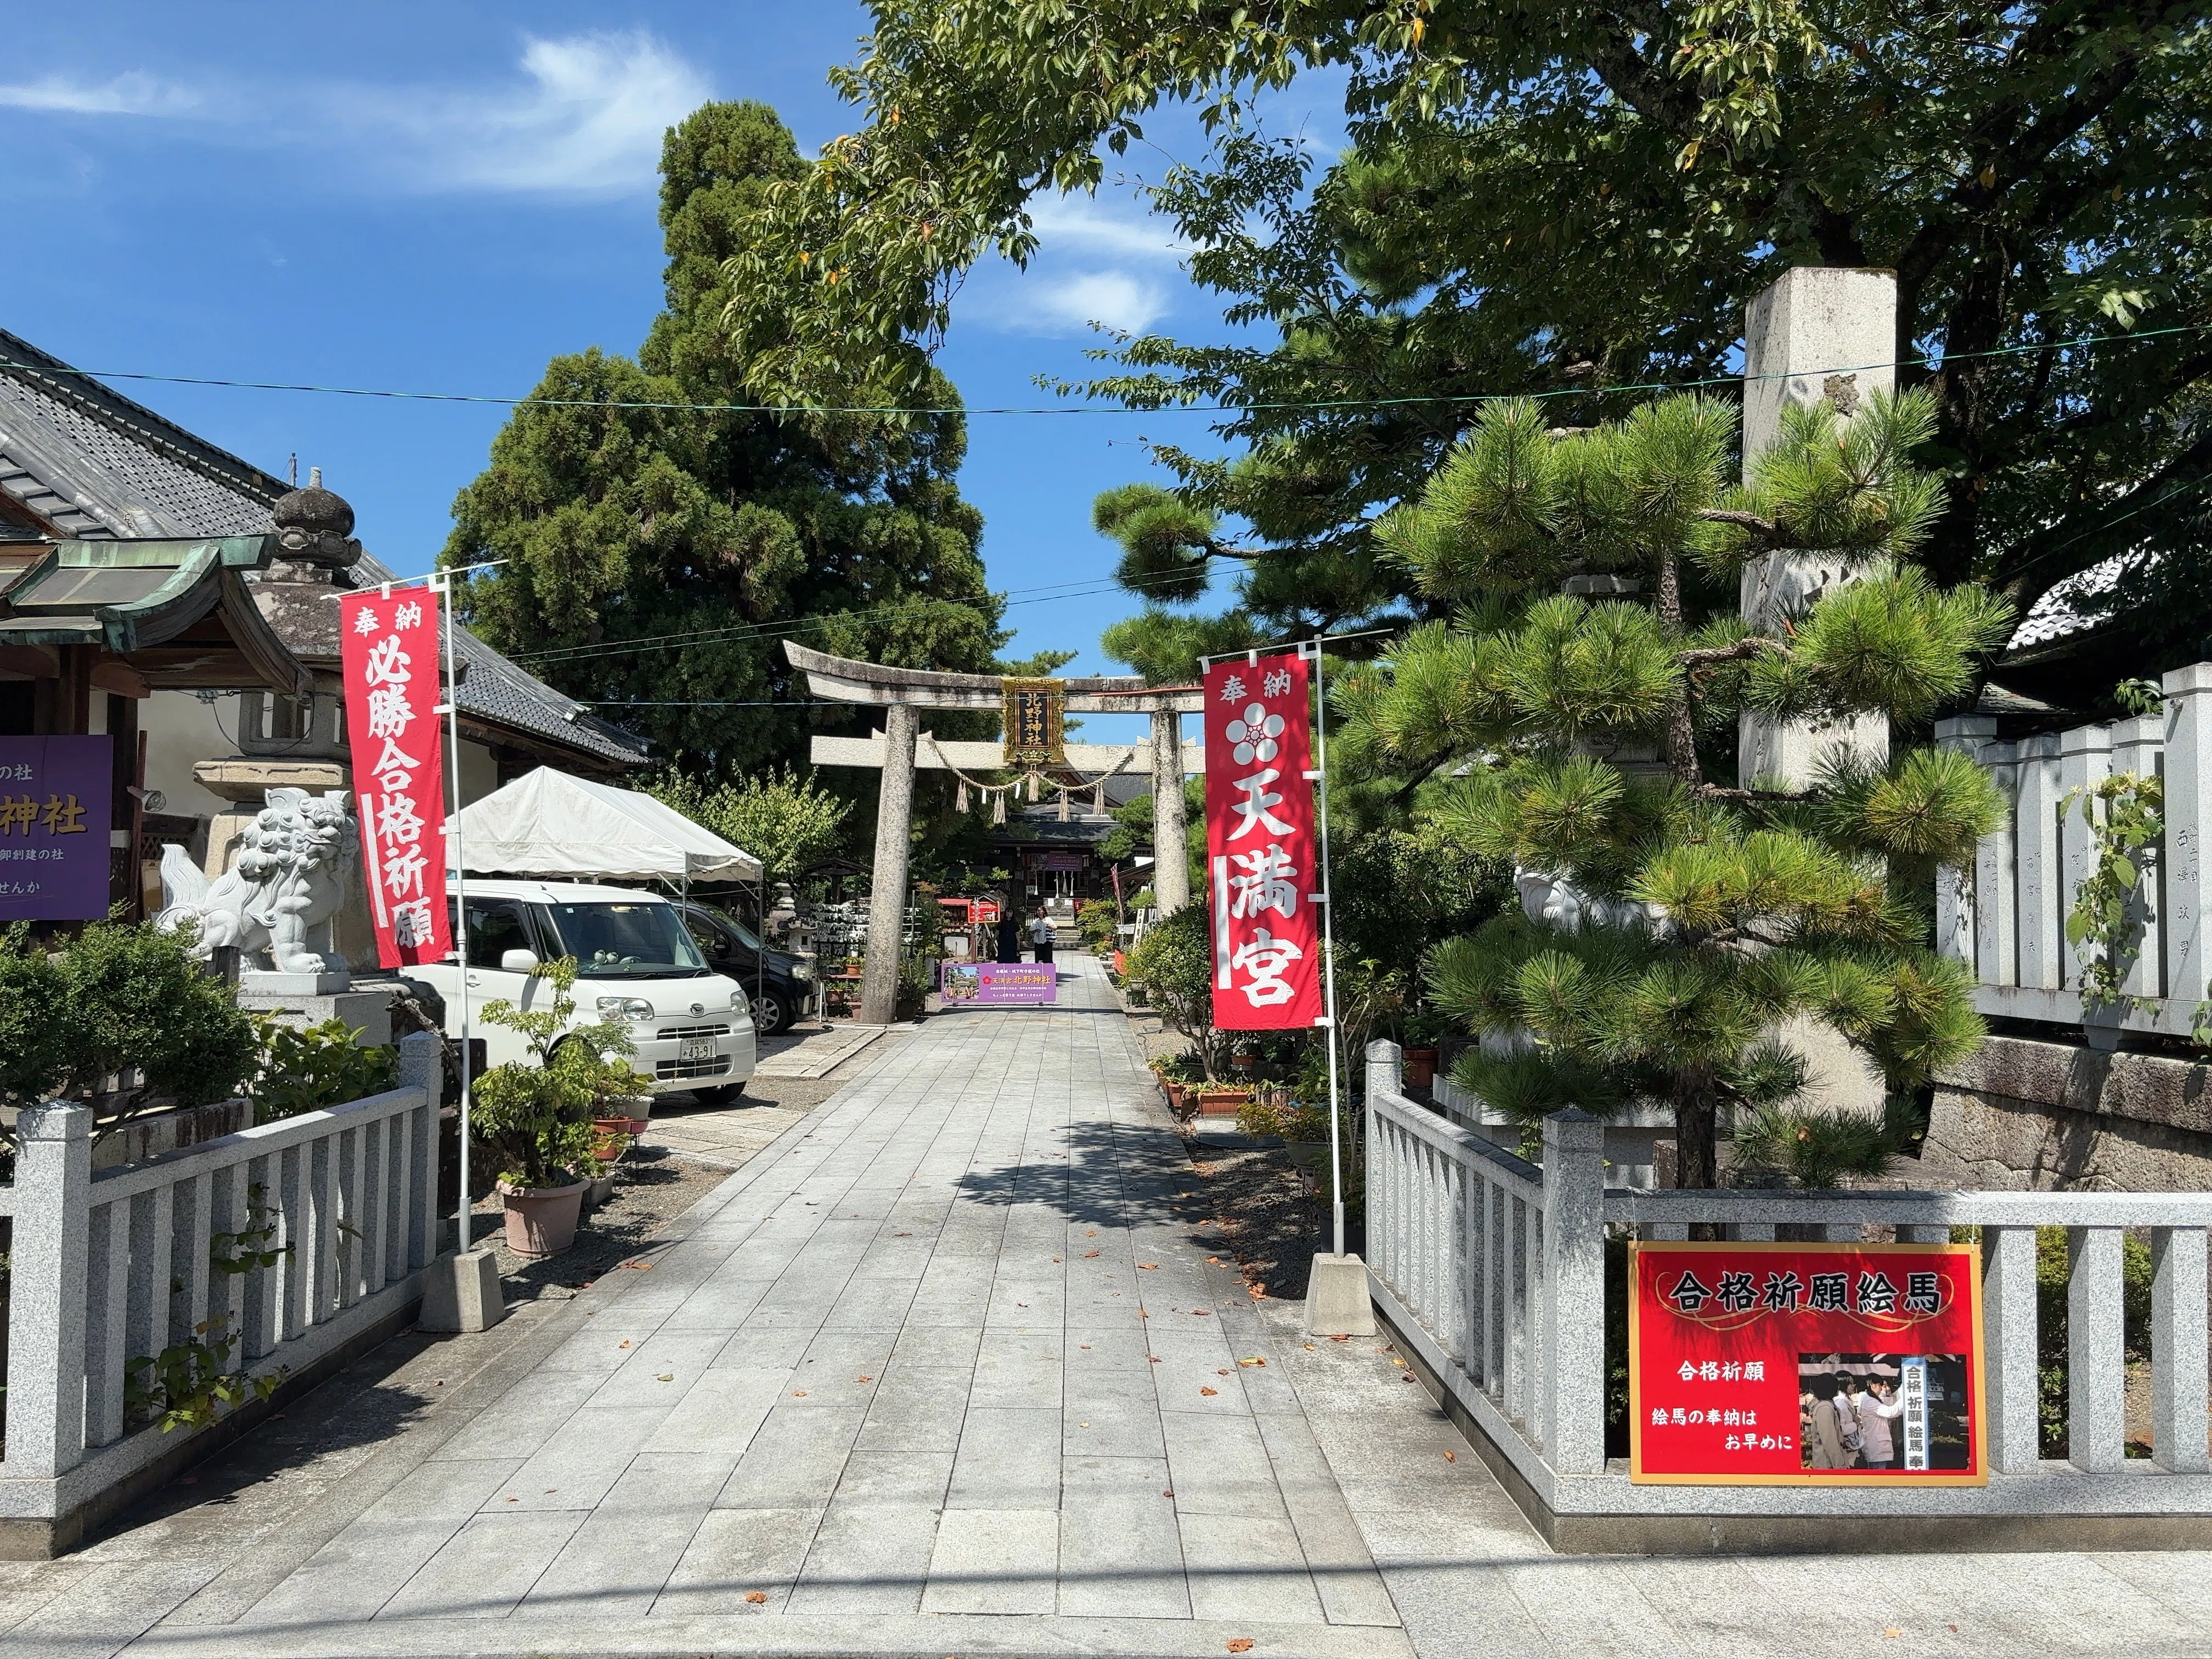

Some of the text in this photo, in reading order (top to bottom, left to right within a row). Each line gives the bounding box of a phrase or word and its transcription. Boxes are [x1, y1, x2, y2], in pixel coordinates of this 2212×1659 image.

[354, 600, 422, 637] 奉納
[1219, 668, 1291, 706] 奉納
[1024, 692, 1043, 746] 北野神社
[364, 633, 435, 947] 必勝合格祈願
[0, 794, 86, 834] 神社
[1226, 768, 1303, 1008] 天満宮
[1013, 975, 1052, 985] 北野神社
[689, 1045, 712, 1058] 43-91
[1669, 1269, 1942, 1316] 合格祈願絵馬
[1677, 1359, 1765, 1382] 合格祈願
[1651, 1407, 1757, 1426] 絵馬の奉納は
[1906, 1365, 1923, 1470] 合格祈願絵馬奉
[1724, 1434, 1792, 1451] お早めに
